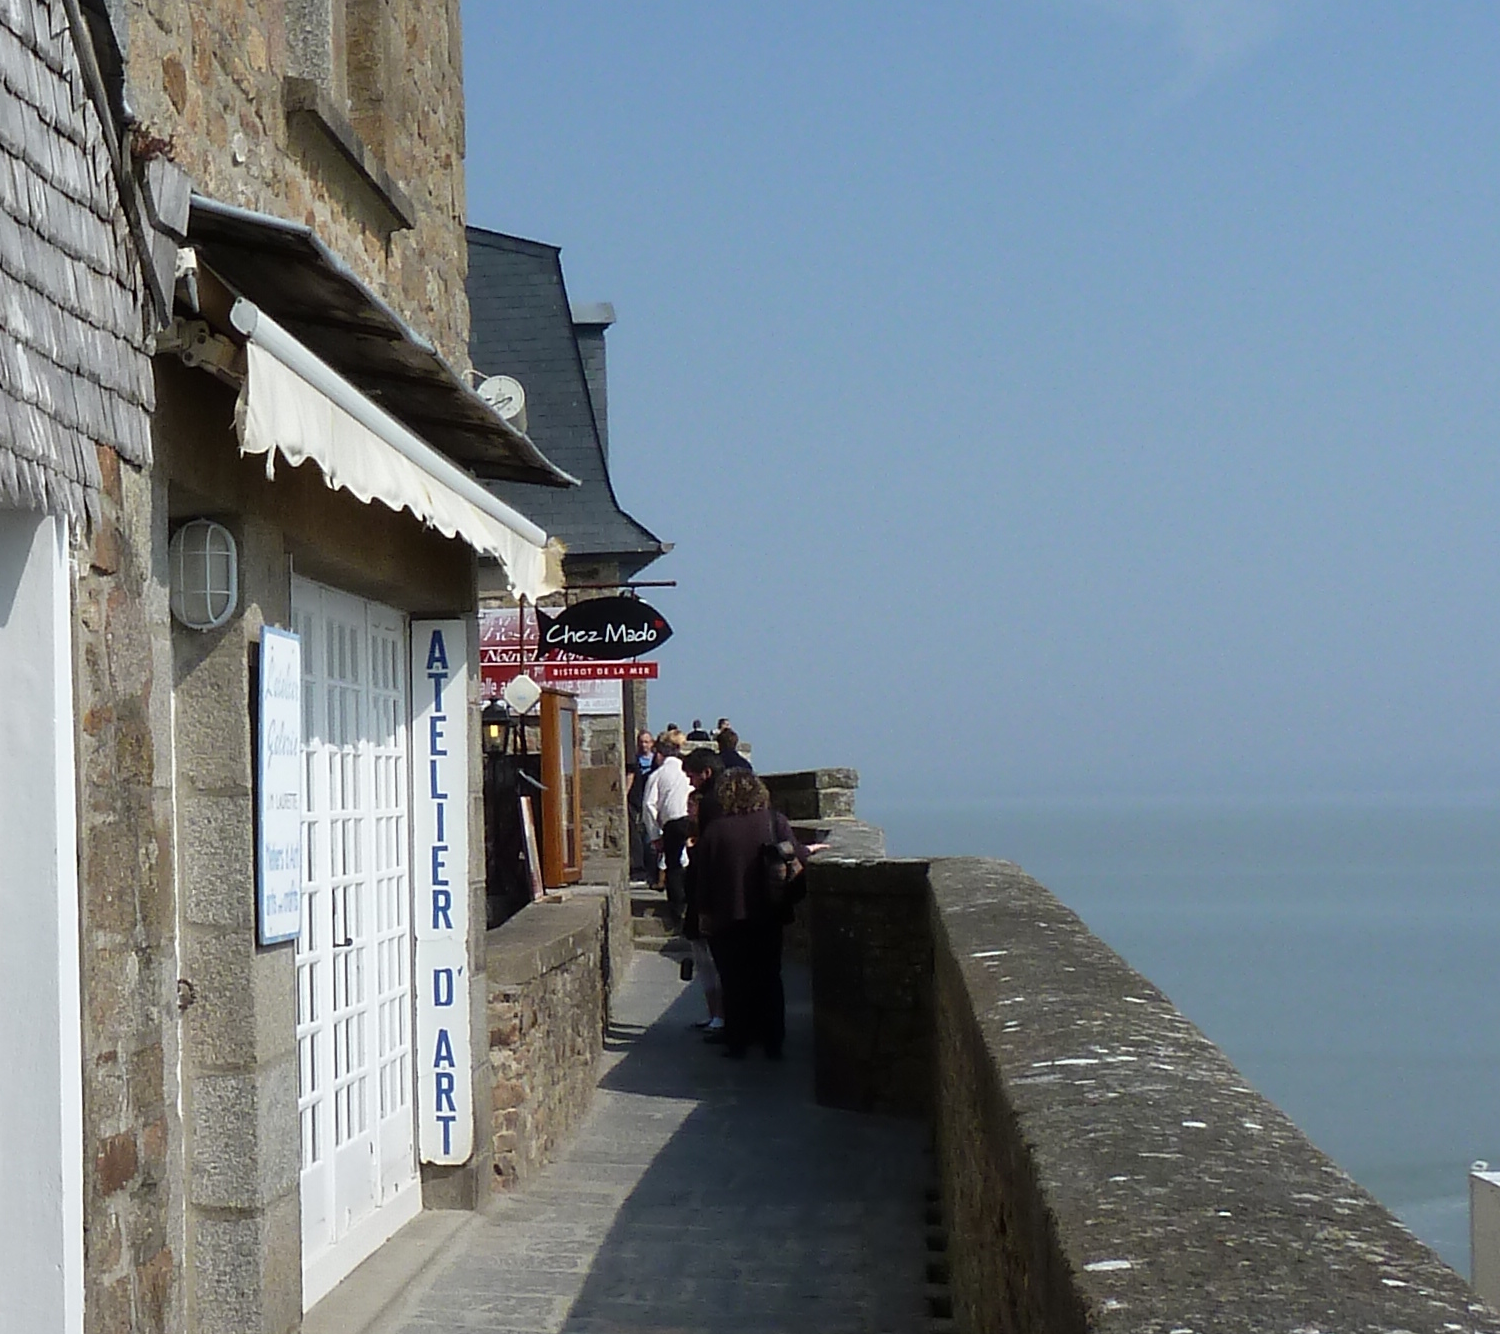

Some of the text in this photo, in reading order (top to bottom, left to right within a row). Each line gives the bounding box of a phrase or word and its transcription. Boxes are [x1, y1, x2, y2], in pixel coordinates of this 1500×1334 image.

[546, 624, 603, 644] Chez
[604, 622, 657, 643] Mado
[553, 667, 650, 677] BISTROT DE LA MER
[426, 629, 453, 930] ATELIER
[433, 1028, 457, 1156] ART
